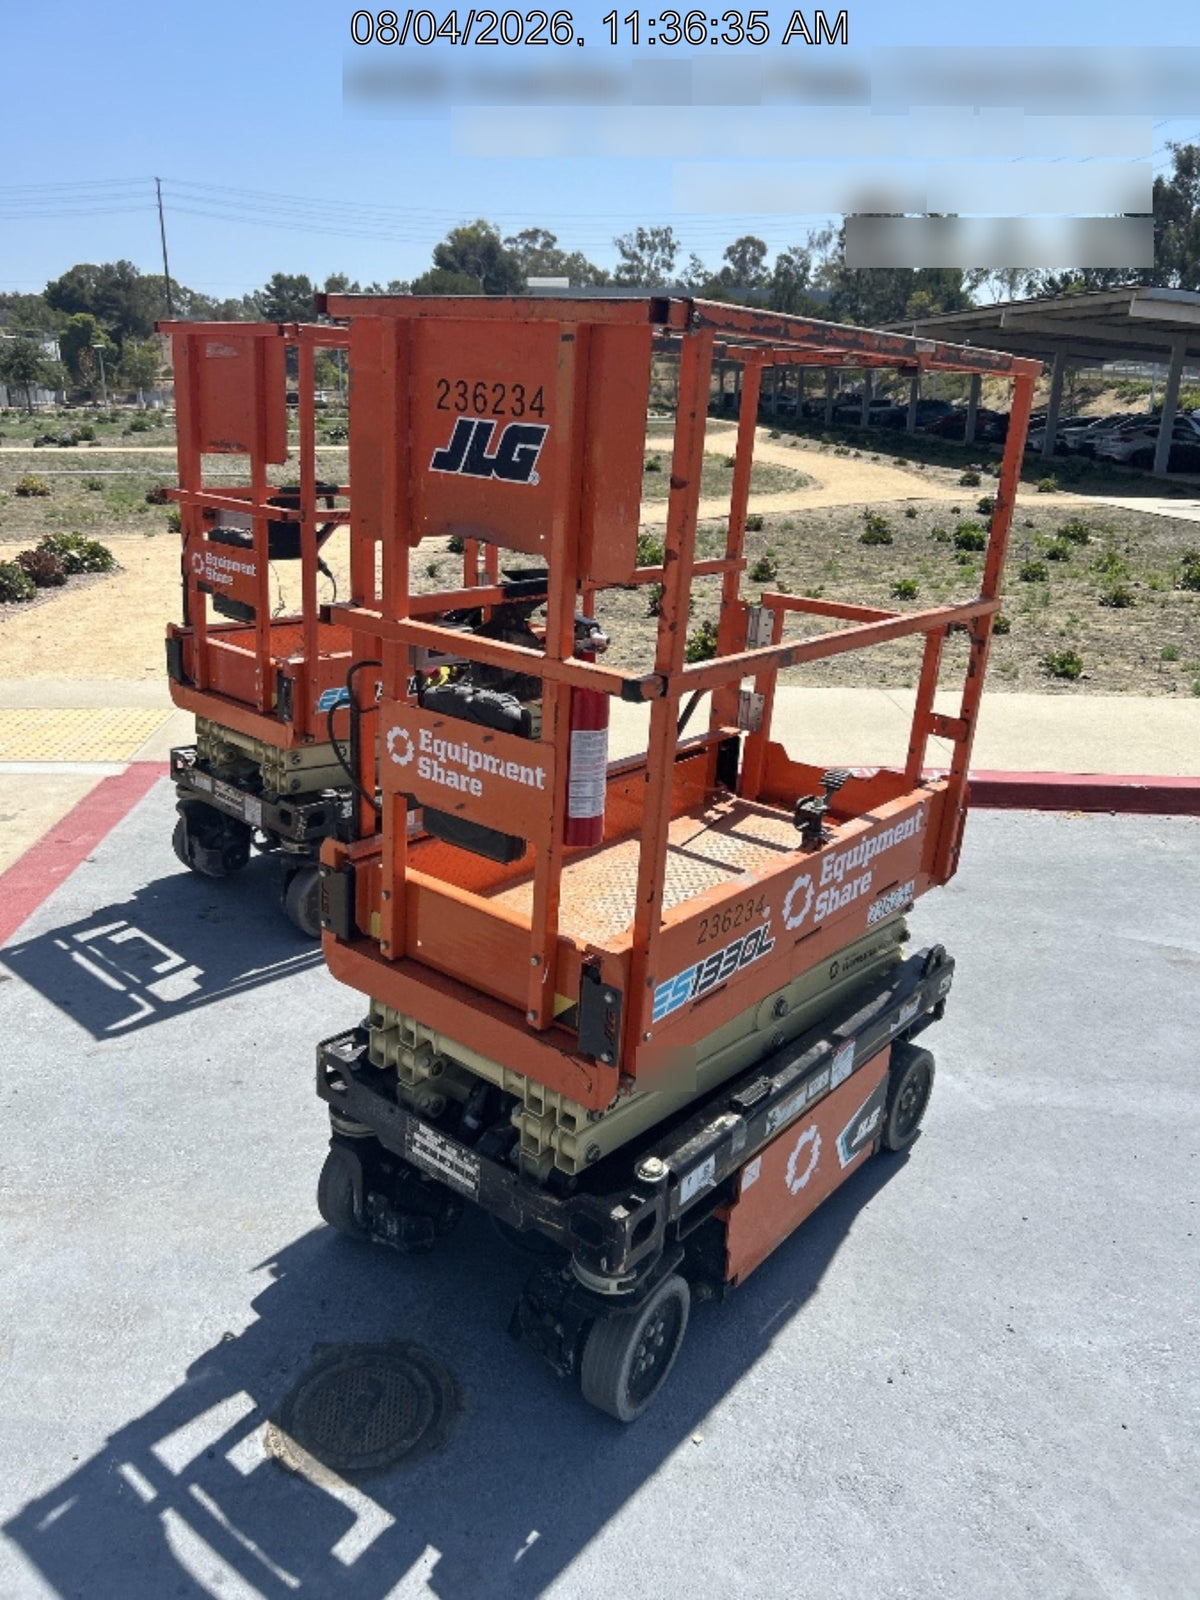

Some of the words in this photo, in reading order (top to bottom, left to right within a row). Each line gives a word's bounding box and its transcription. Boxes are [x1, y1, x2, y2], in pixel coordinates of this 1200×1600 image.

[436, 378, 545, 418] 236234
[428, 416, 550, 484] JLG
[417, 756, 483, 797] Share
[418, 728, 547, 790] Equipment
[820, 808, 923, 886] Equipment
[697, 894, 766, 945] 236234
[814, 871, 872, 923] Share
[652, 920, 776, 1024] ES1330L
